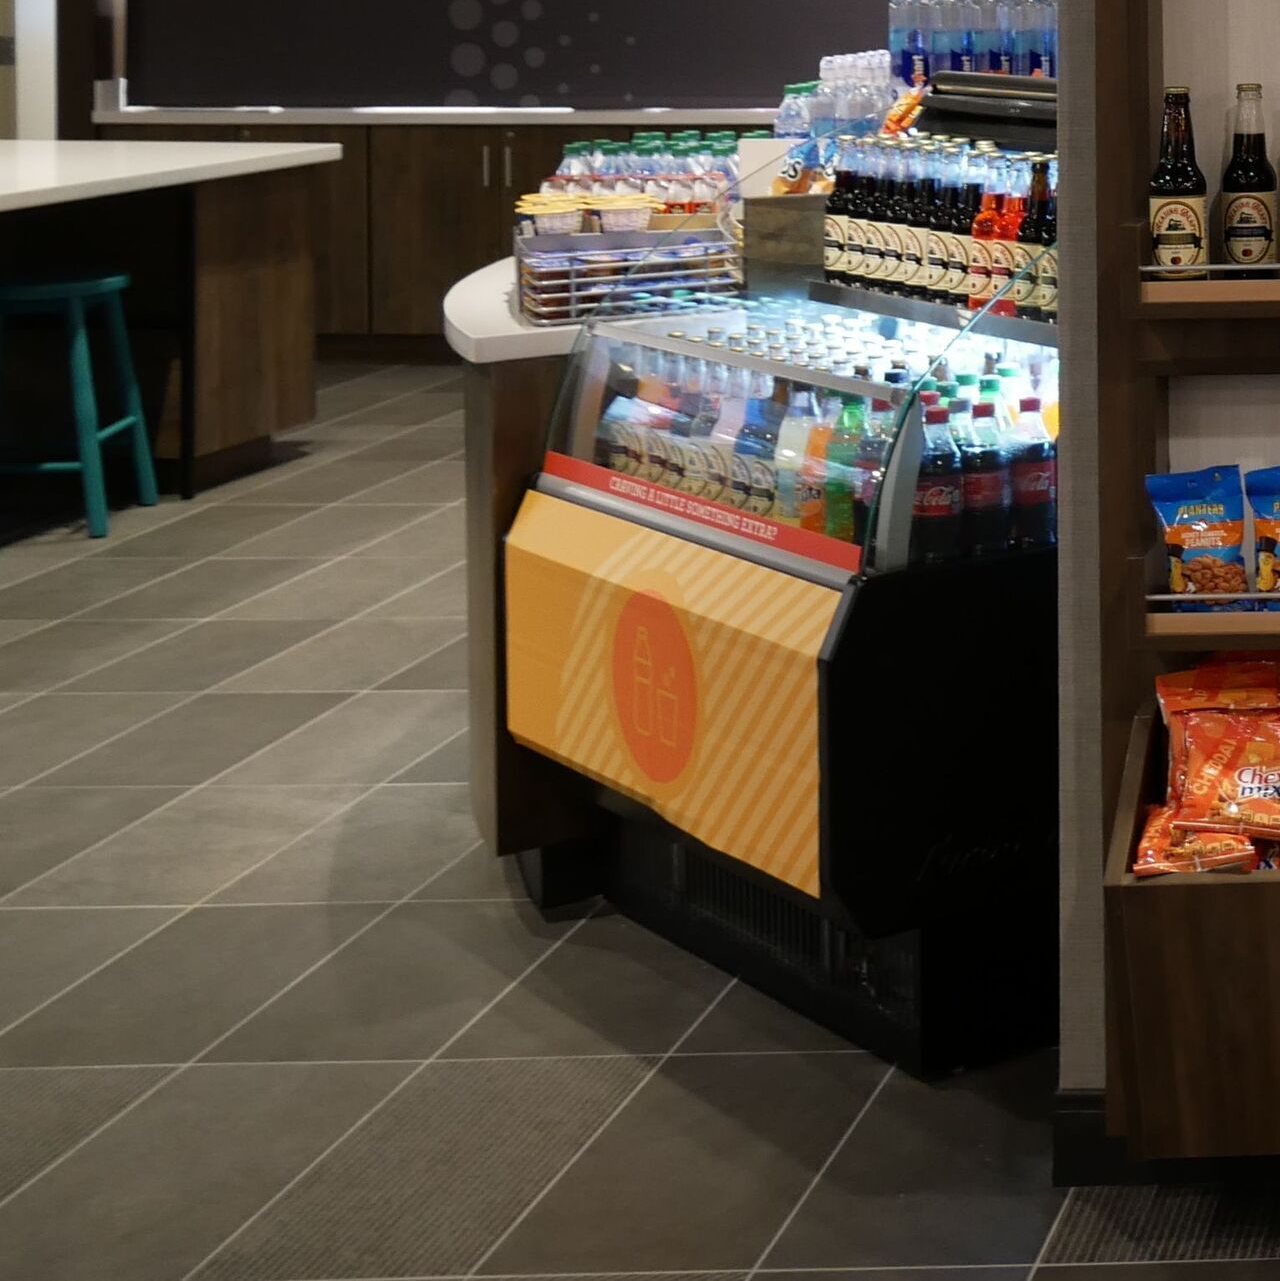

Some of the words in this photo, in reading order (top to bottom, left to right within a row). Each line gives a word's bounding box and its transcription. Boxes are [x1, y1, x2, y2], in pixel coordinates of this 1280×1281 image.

[609, 476, 647, 502] CRAVING
[655, 490, 685, 513] LITTLE
[686, 500, 740, 529] SOMETHING
[740, 517, 778, 541] EXTRA?
[1178, 503, 1225, 517] PLANTERS
[1184, 536, 1222, 548] PEANUTS
